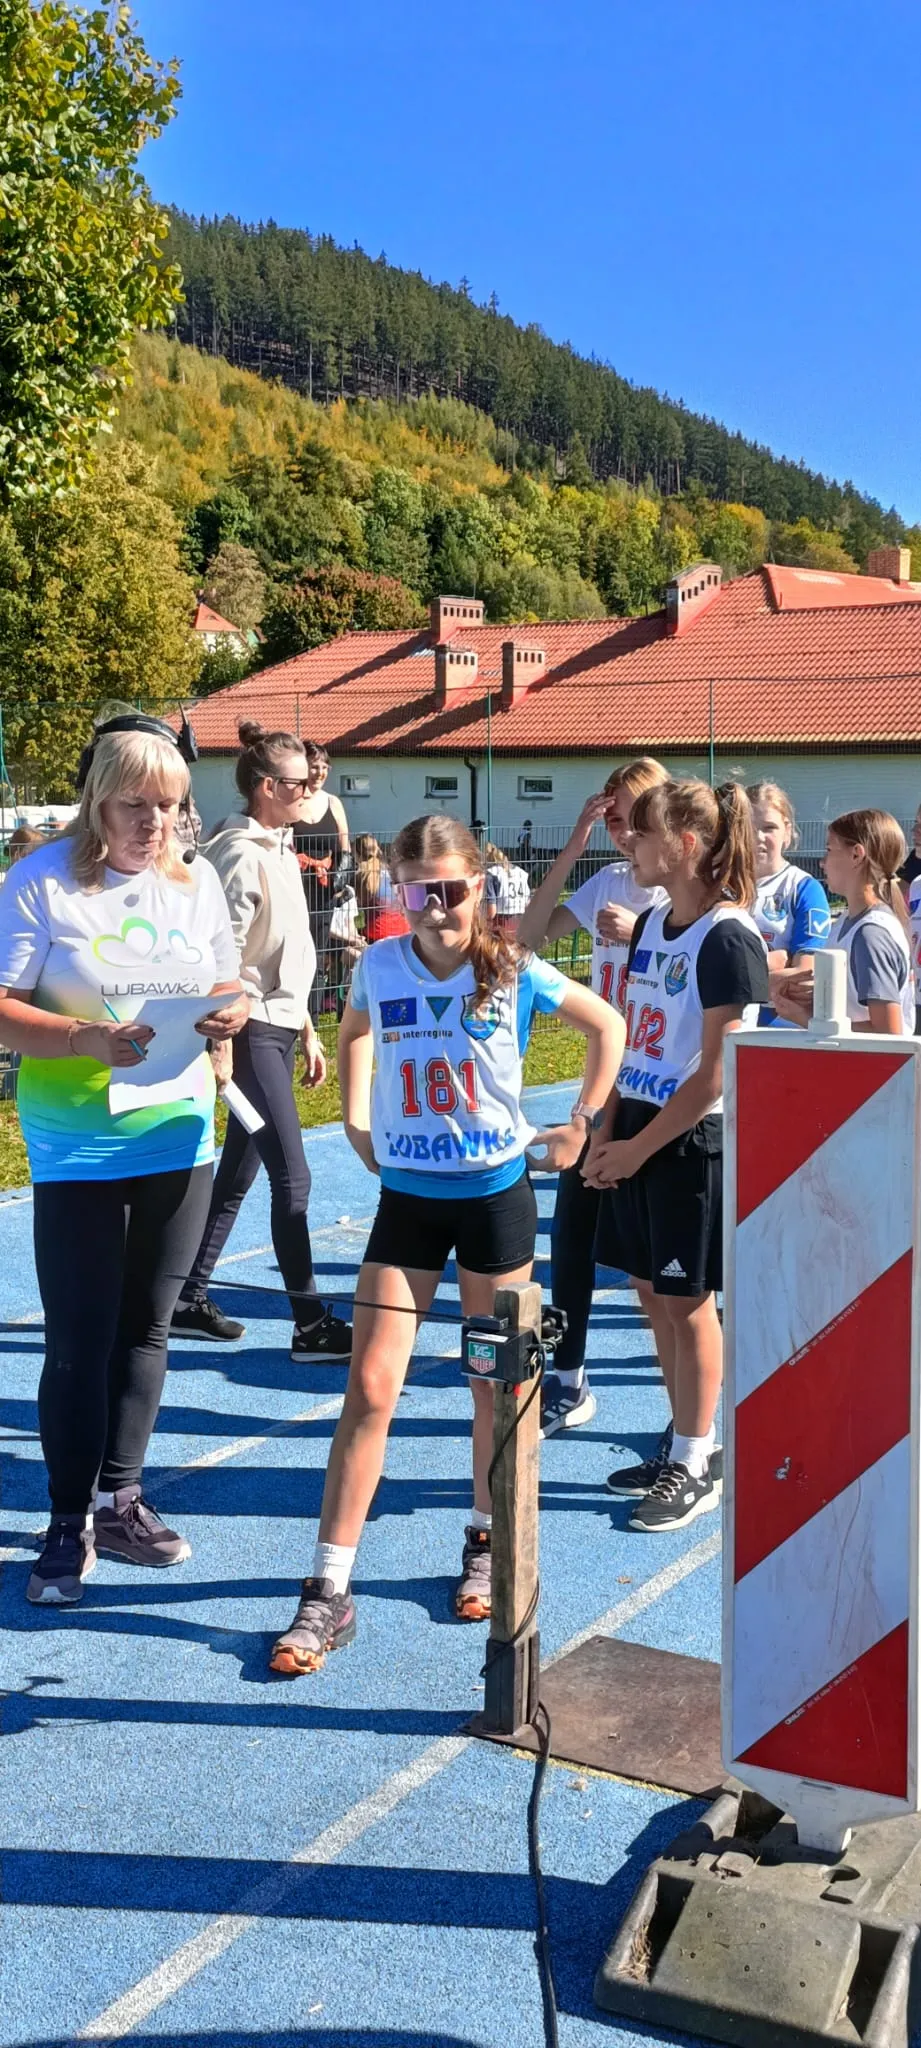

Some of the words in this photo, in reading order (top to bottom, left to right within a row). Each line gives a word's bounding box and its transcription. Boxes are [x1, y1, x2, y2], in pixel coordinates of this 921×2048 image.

[101, 982, 200, 996] LUBAWKA
[600, 961, 629, 1009] 18
[400, 1057, 484, 1117] 181
